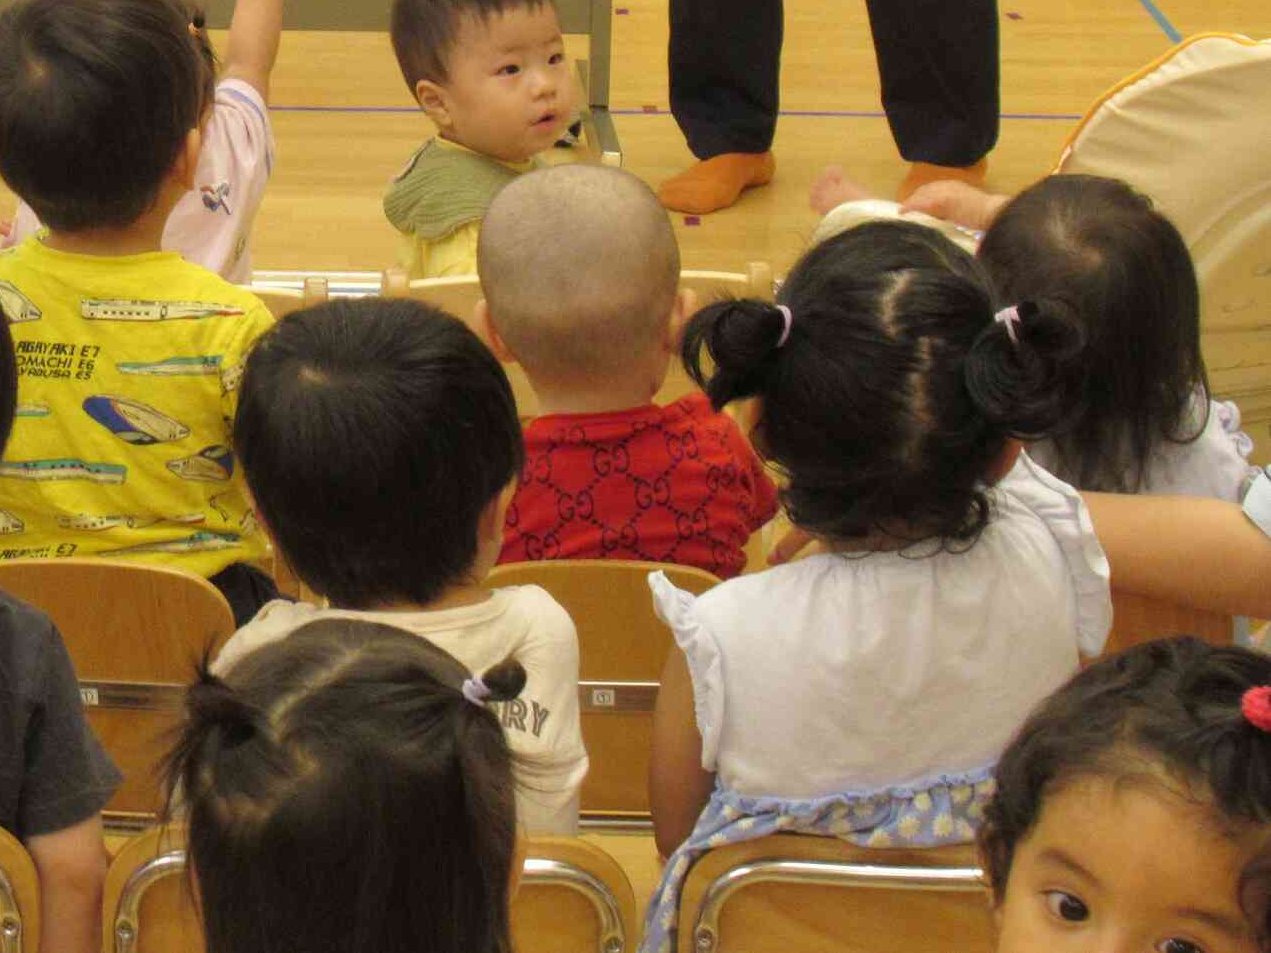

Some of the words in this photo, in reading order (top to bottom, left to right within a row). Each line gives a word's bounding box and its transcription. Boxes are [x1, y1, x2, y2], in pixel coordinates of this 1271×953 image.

[16, 342, 76, 357] AGAYAKI
[80, 344, 101, 358] E7
[16, 355, 73, 369] OMACHI
[494, 697, 551, 739] RY
